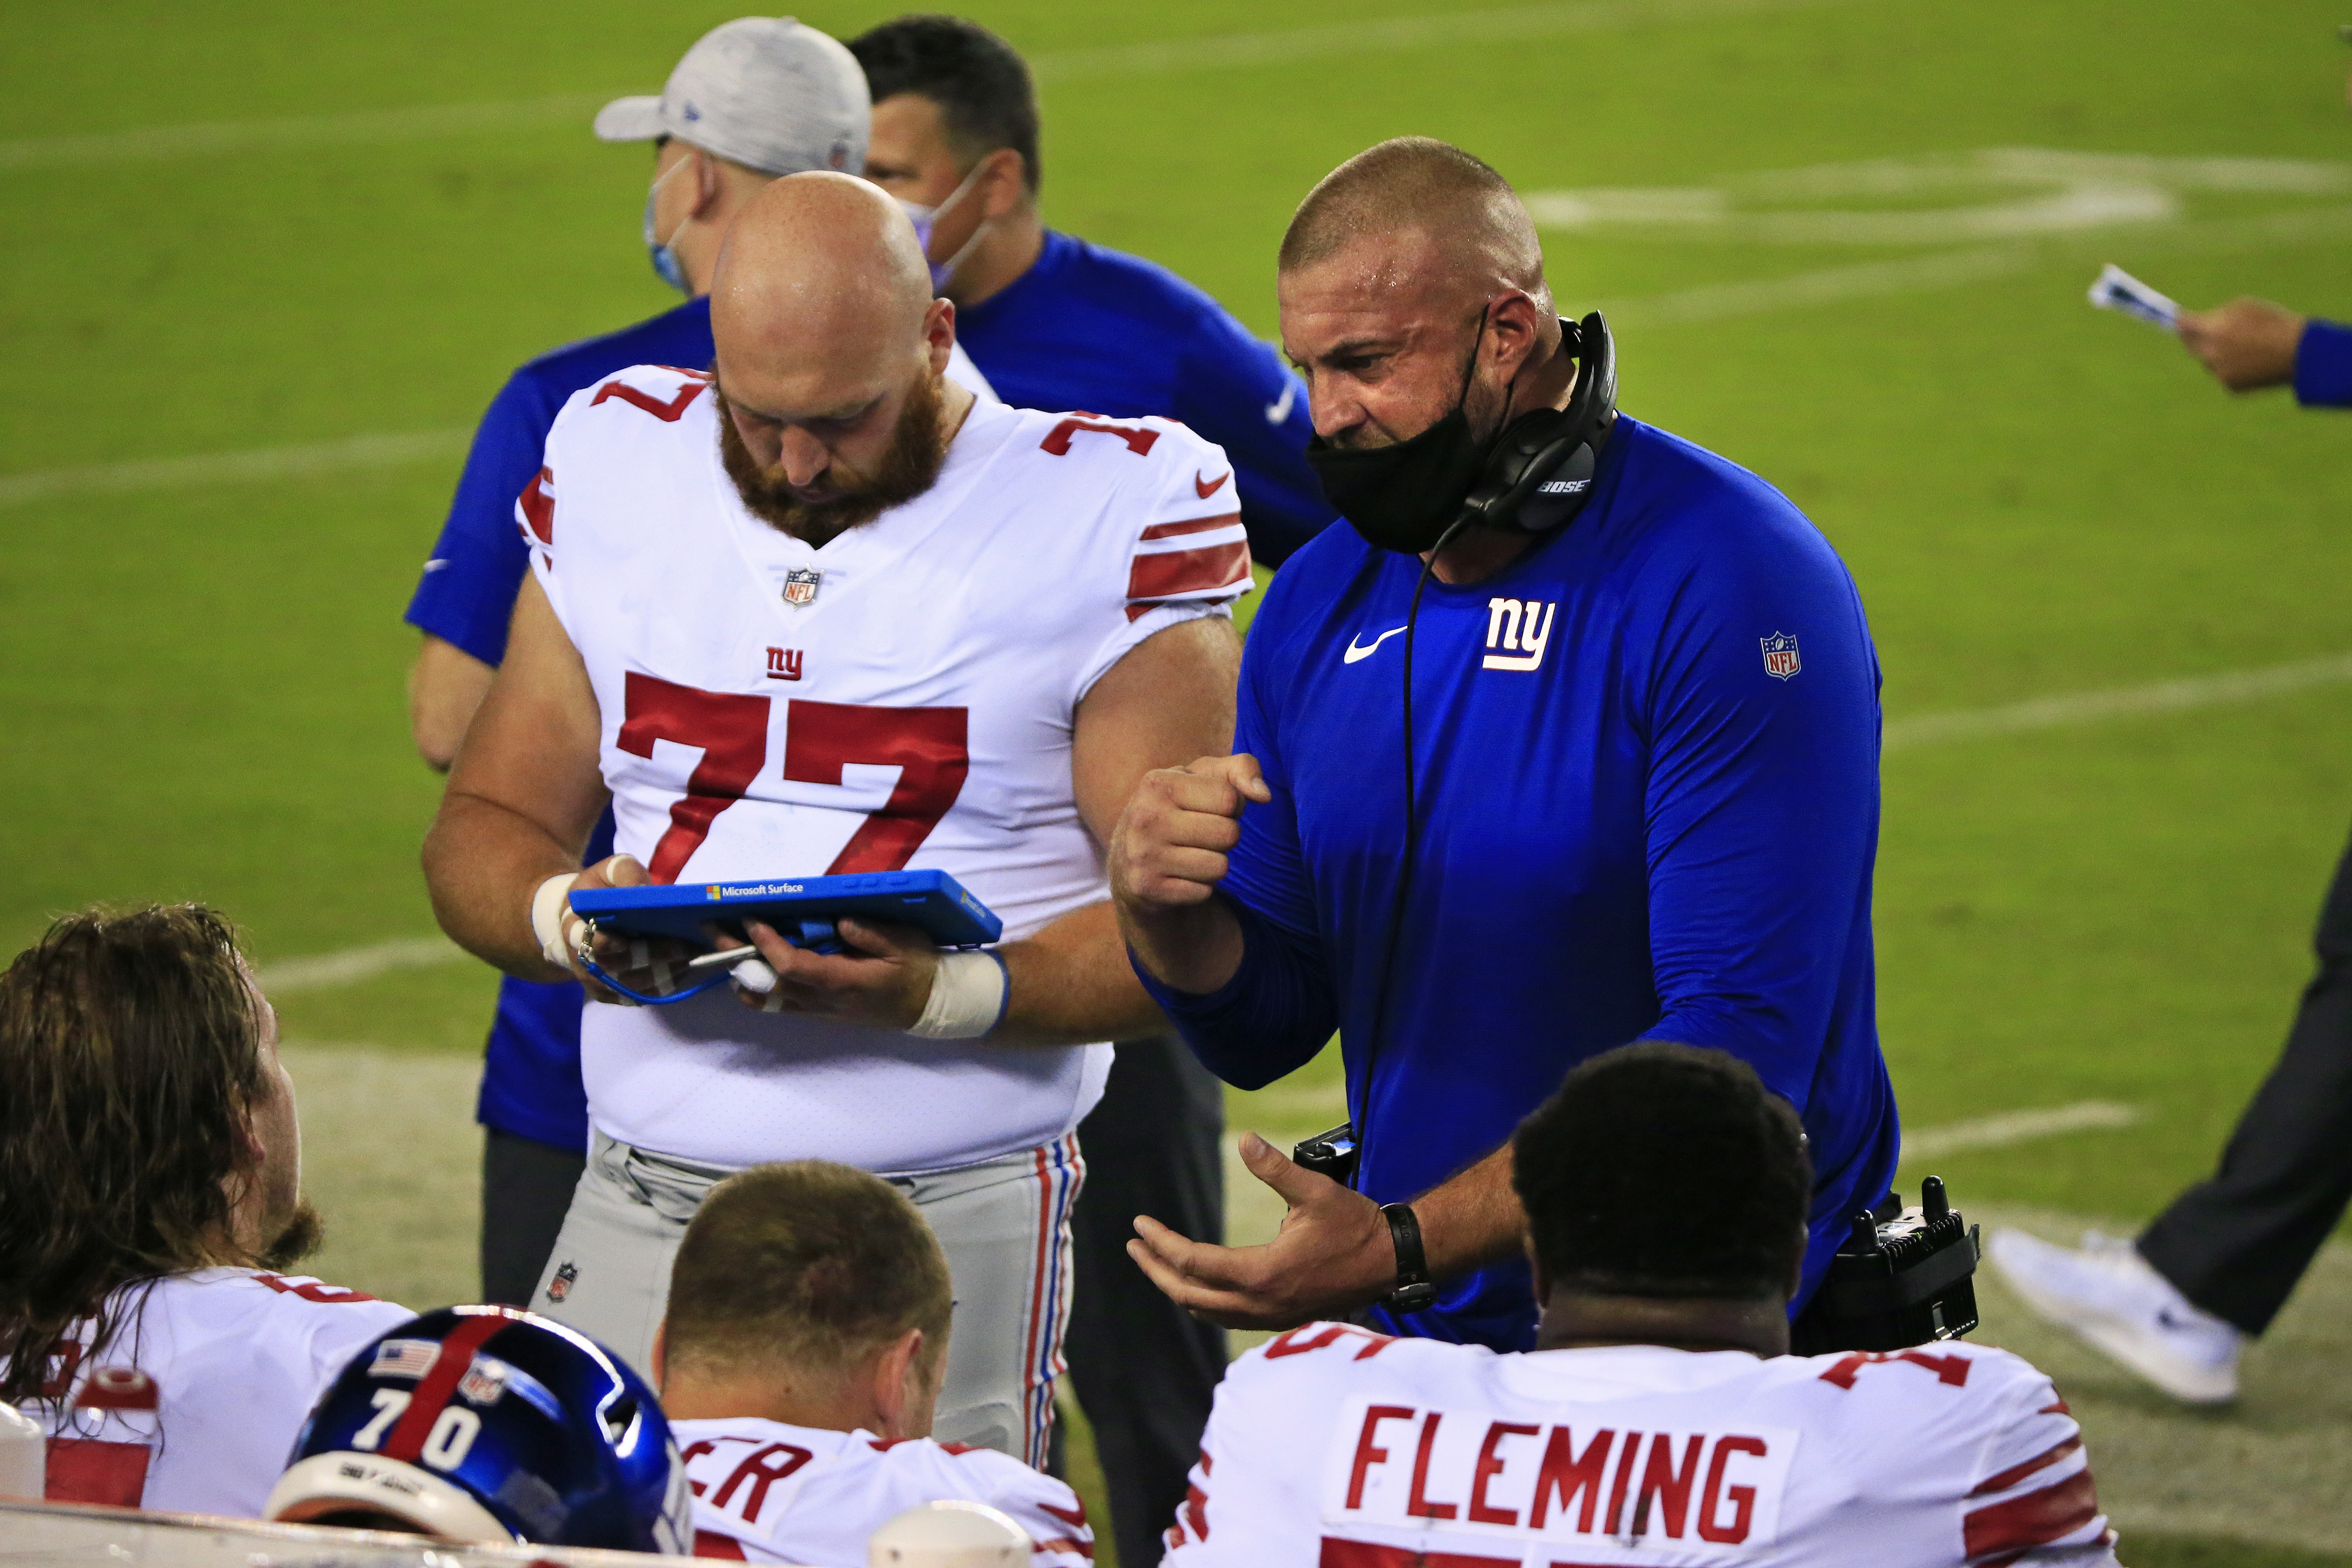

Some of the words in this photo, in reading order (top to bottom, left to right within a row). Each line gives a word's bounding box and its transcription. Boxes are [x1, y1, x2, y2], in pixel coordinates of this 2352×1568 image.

[1537, 479, 1591, 493] BOSE
[785, 583, 811, 602] NFL
[1768, 652, 1797, 674] NFL
[616, 670, 969, 884] 77
[722, 884, 766, 896] Microsoft
[768, 882, 804, 894] Surface
[1346, 1405, 1767, 1544] FLEMING
